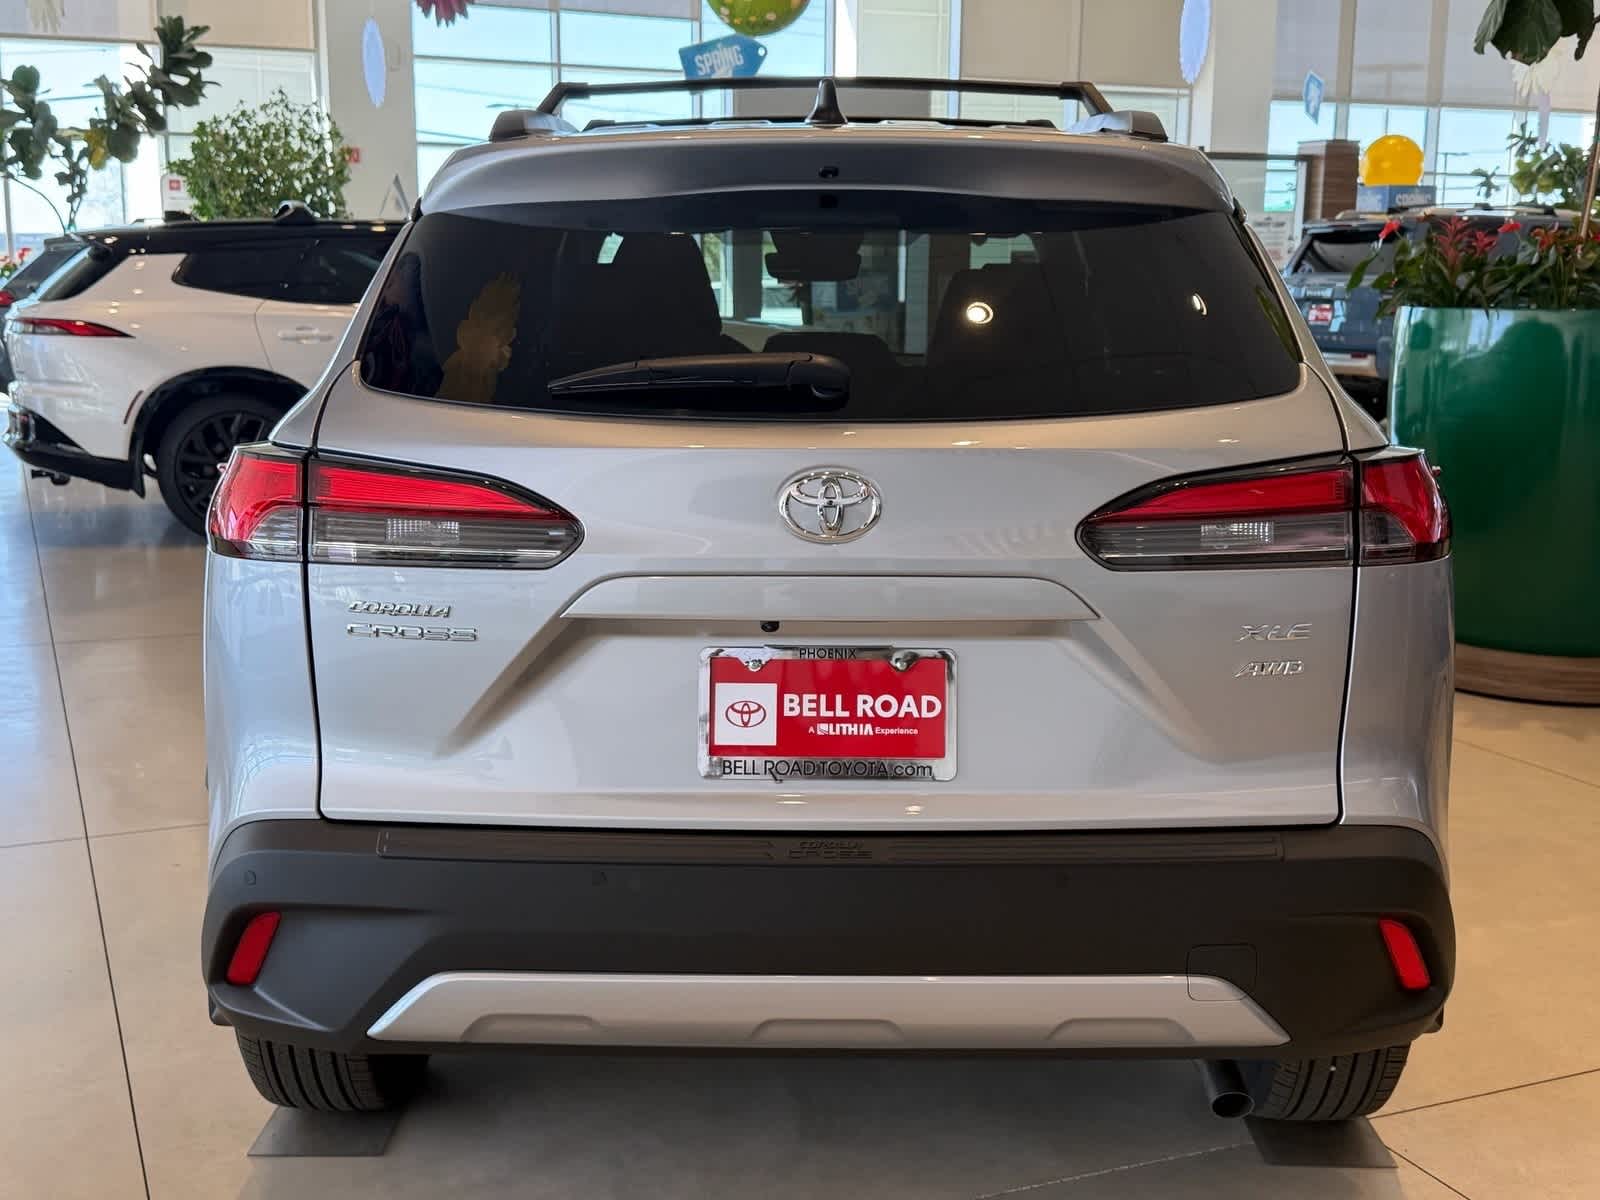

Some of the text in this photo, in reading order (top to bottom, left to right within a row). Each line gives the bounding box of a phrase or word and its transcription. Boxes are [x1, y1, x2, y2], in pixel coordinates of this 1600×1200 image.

[694, 43, 745, 76] SPRING
[348, 600, 452, 618] COROLLA
[346, 622, 477, 641] CROSS
[1236, 623, 1312, 641] XLE
[799, 648, 857, 660] PHOENIX
[1233, 660, 1304, 678] AWD
[783, 693, 942, 719] BELL ROAD
[808, 723, 919, 736] A LITHIA Experience
